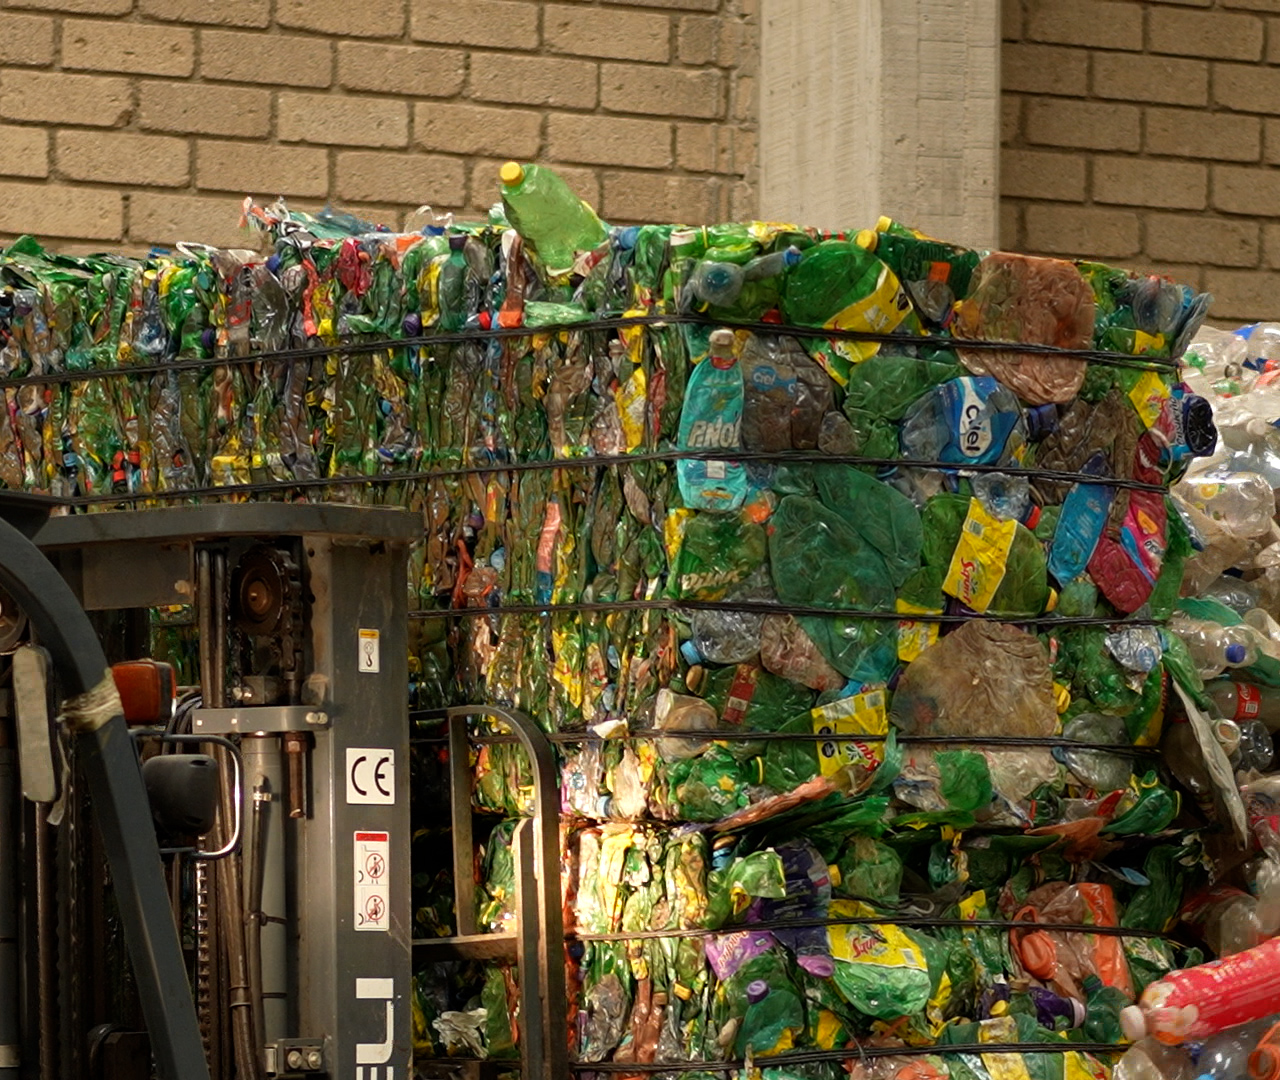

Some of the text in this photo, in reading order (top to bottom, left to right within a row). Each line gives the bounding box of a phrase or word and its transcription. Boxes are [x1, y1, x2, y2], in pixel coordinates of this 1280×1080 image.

[965, 404, 981, 452] Ciel
[960, 557, 975, 605] Squirt
[351, 756, 391, 797] CE
